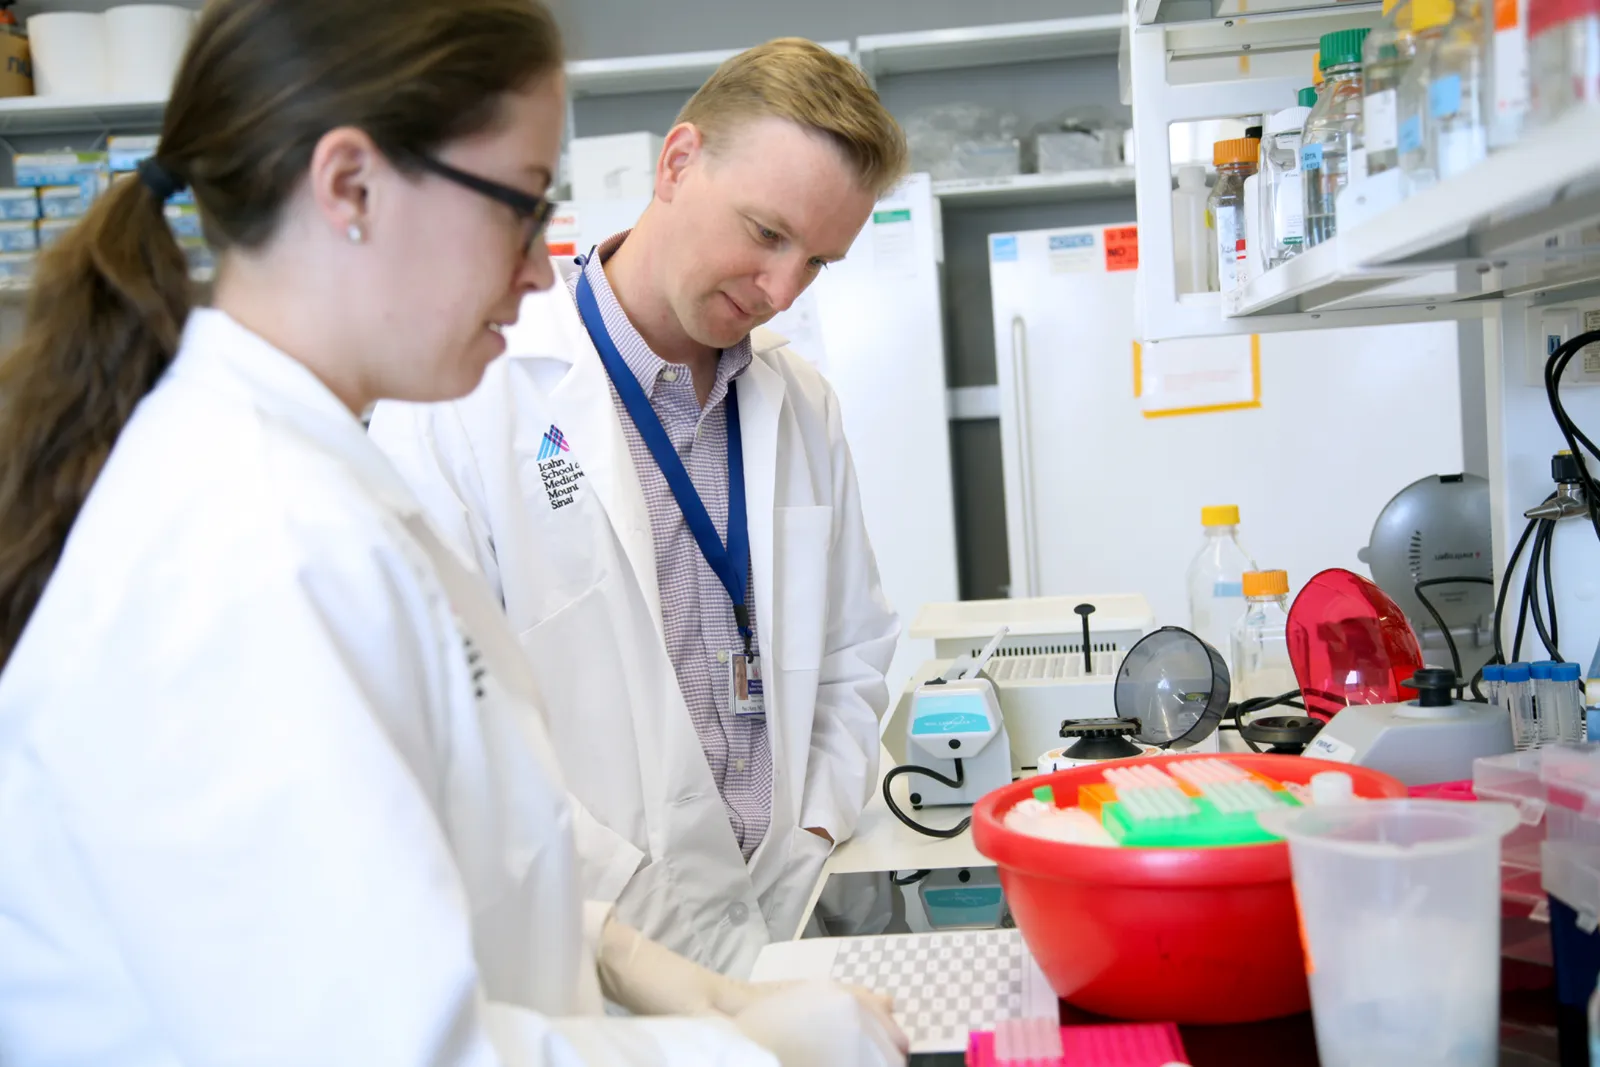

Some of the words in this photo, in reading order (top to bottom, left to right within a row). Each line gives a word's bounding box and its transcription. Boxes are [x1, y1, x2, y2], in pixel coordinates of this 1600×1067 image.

[538, 459, 565, 472] Icahn
[541, 463, 574, 481] School
[547, 483, 579, 500] Mount
[551, 494, 574, 510] Sinai
